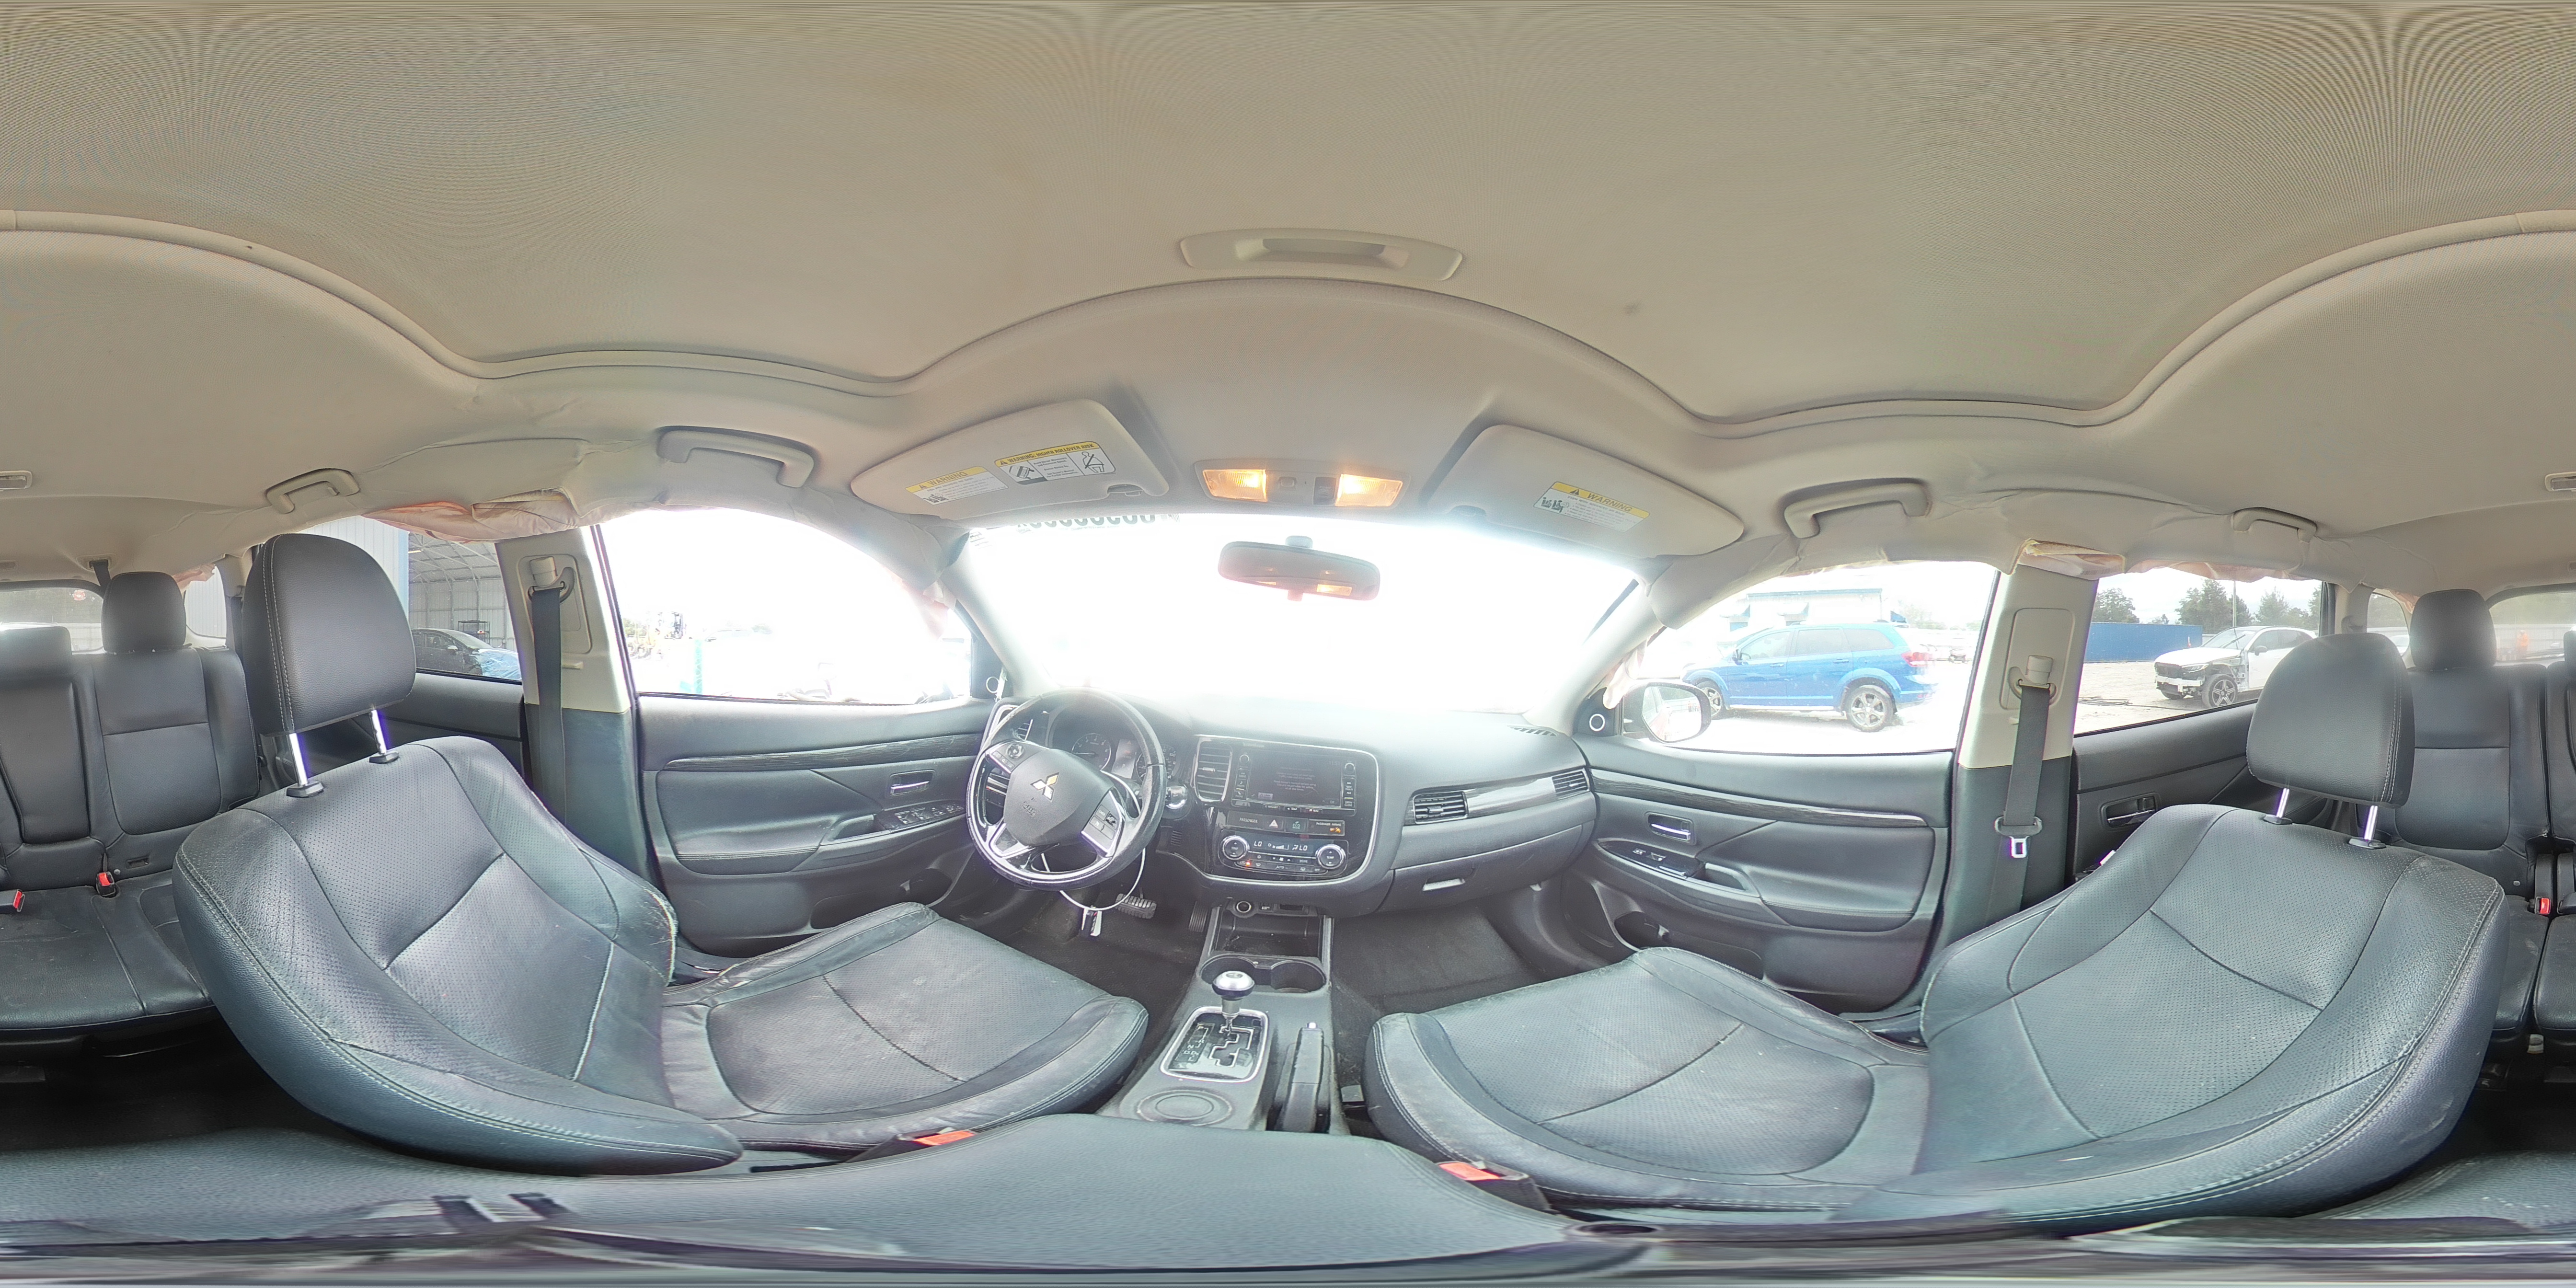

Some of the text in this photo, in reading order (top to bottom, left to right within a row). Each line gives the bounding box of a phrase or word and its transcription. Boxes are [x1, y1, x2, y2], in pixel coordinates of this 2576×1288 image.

[1008, 454, 1035, 462] WARNING:
[1055, 445, 1081, 453] ROLLOVER
[928, 472, 968, 486] WARNING
[1587, 493, 1633, 512] WARNING
